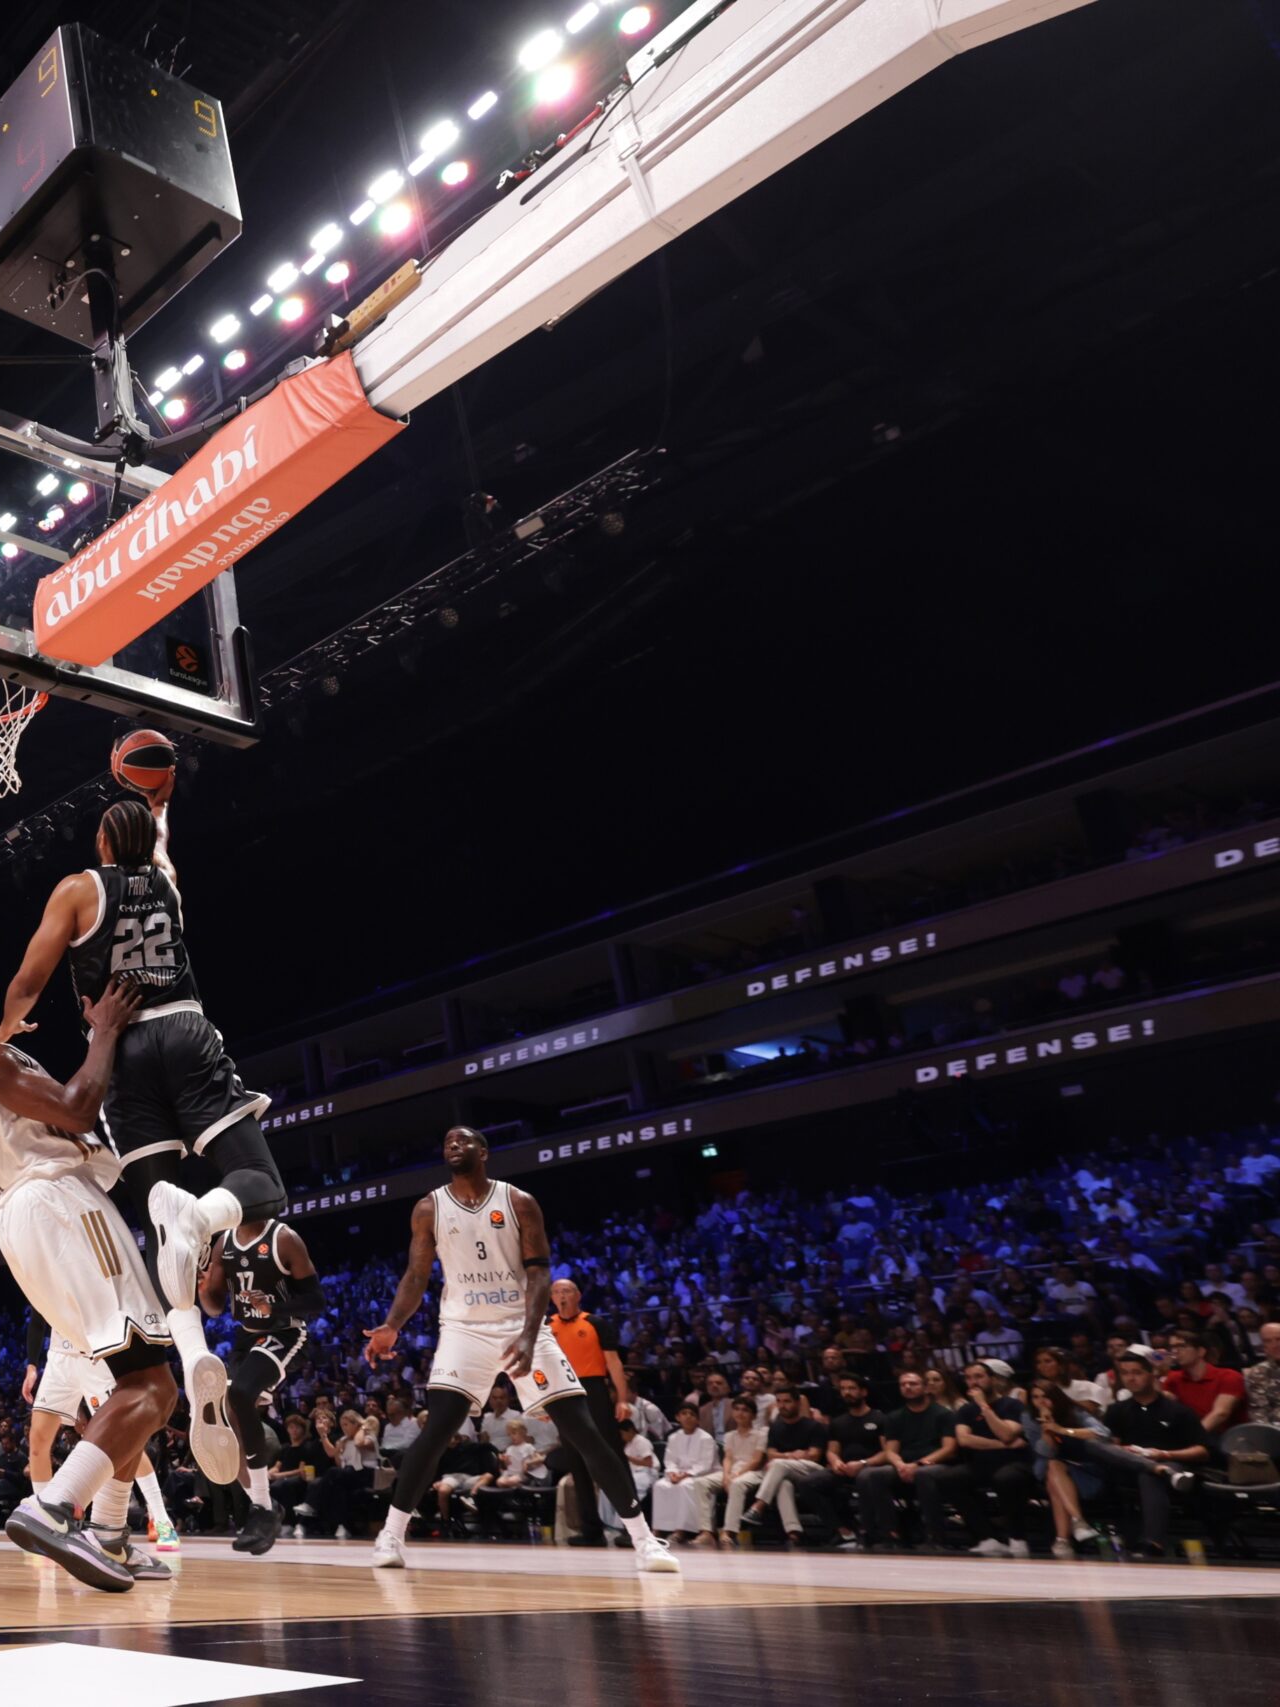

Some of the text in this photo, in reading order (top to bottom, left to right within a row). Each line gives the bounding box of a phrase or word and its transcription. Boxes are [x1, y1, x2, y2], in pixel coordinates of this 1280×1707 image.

[193, 99, 217, 137] 9
[51, 493, 158, 584] experience
[135, 496, 272, 603] abu dhabi
[216, 511, 291, 567] experience
[45, 554, 124, 628] abu
[168, 666, 209, 687] EuroLeague
[110, 911, 176, 975] 22
[746, 932, 937, 997] DEFENSE!
[465, 1027, 600, 1076] DEFENSE!
[915, 1018, 1156, 1084] DEFENSE!
[538, 1117, 693, 1164] DEFENSE!
[475, 1240, 488, 1261] 3
[235, 1271, 255, 1292] 17
[464, 1287, 520, 1306] dnata
[560, 1358, 577, 1384] 3
